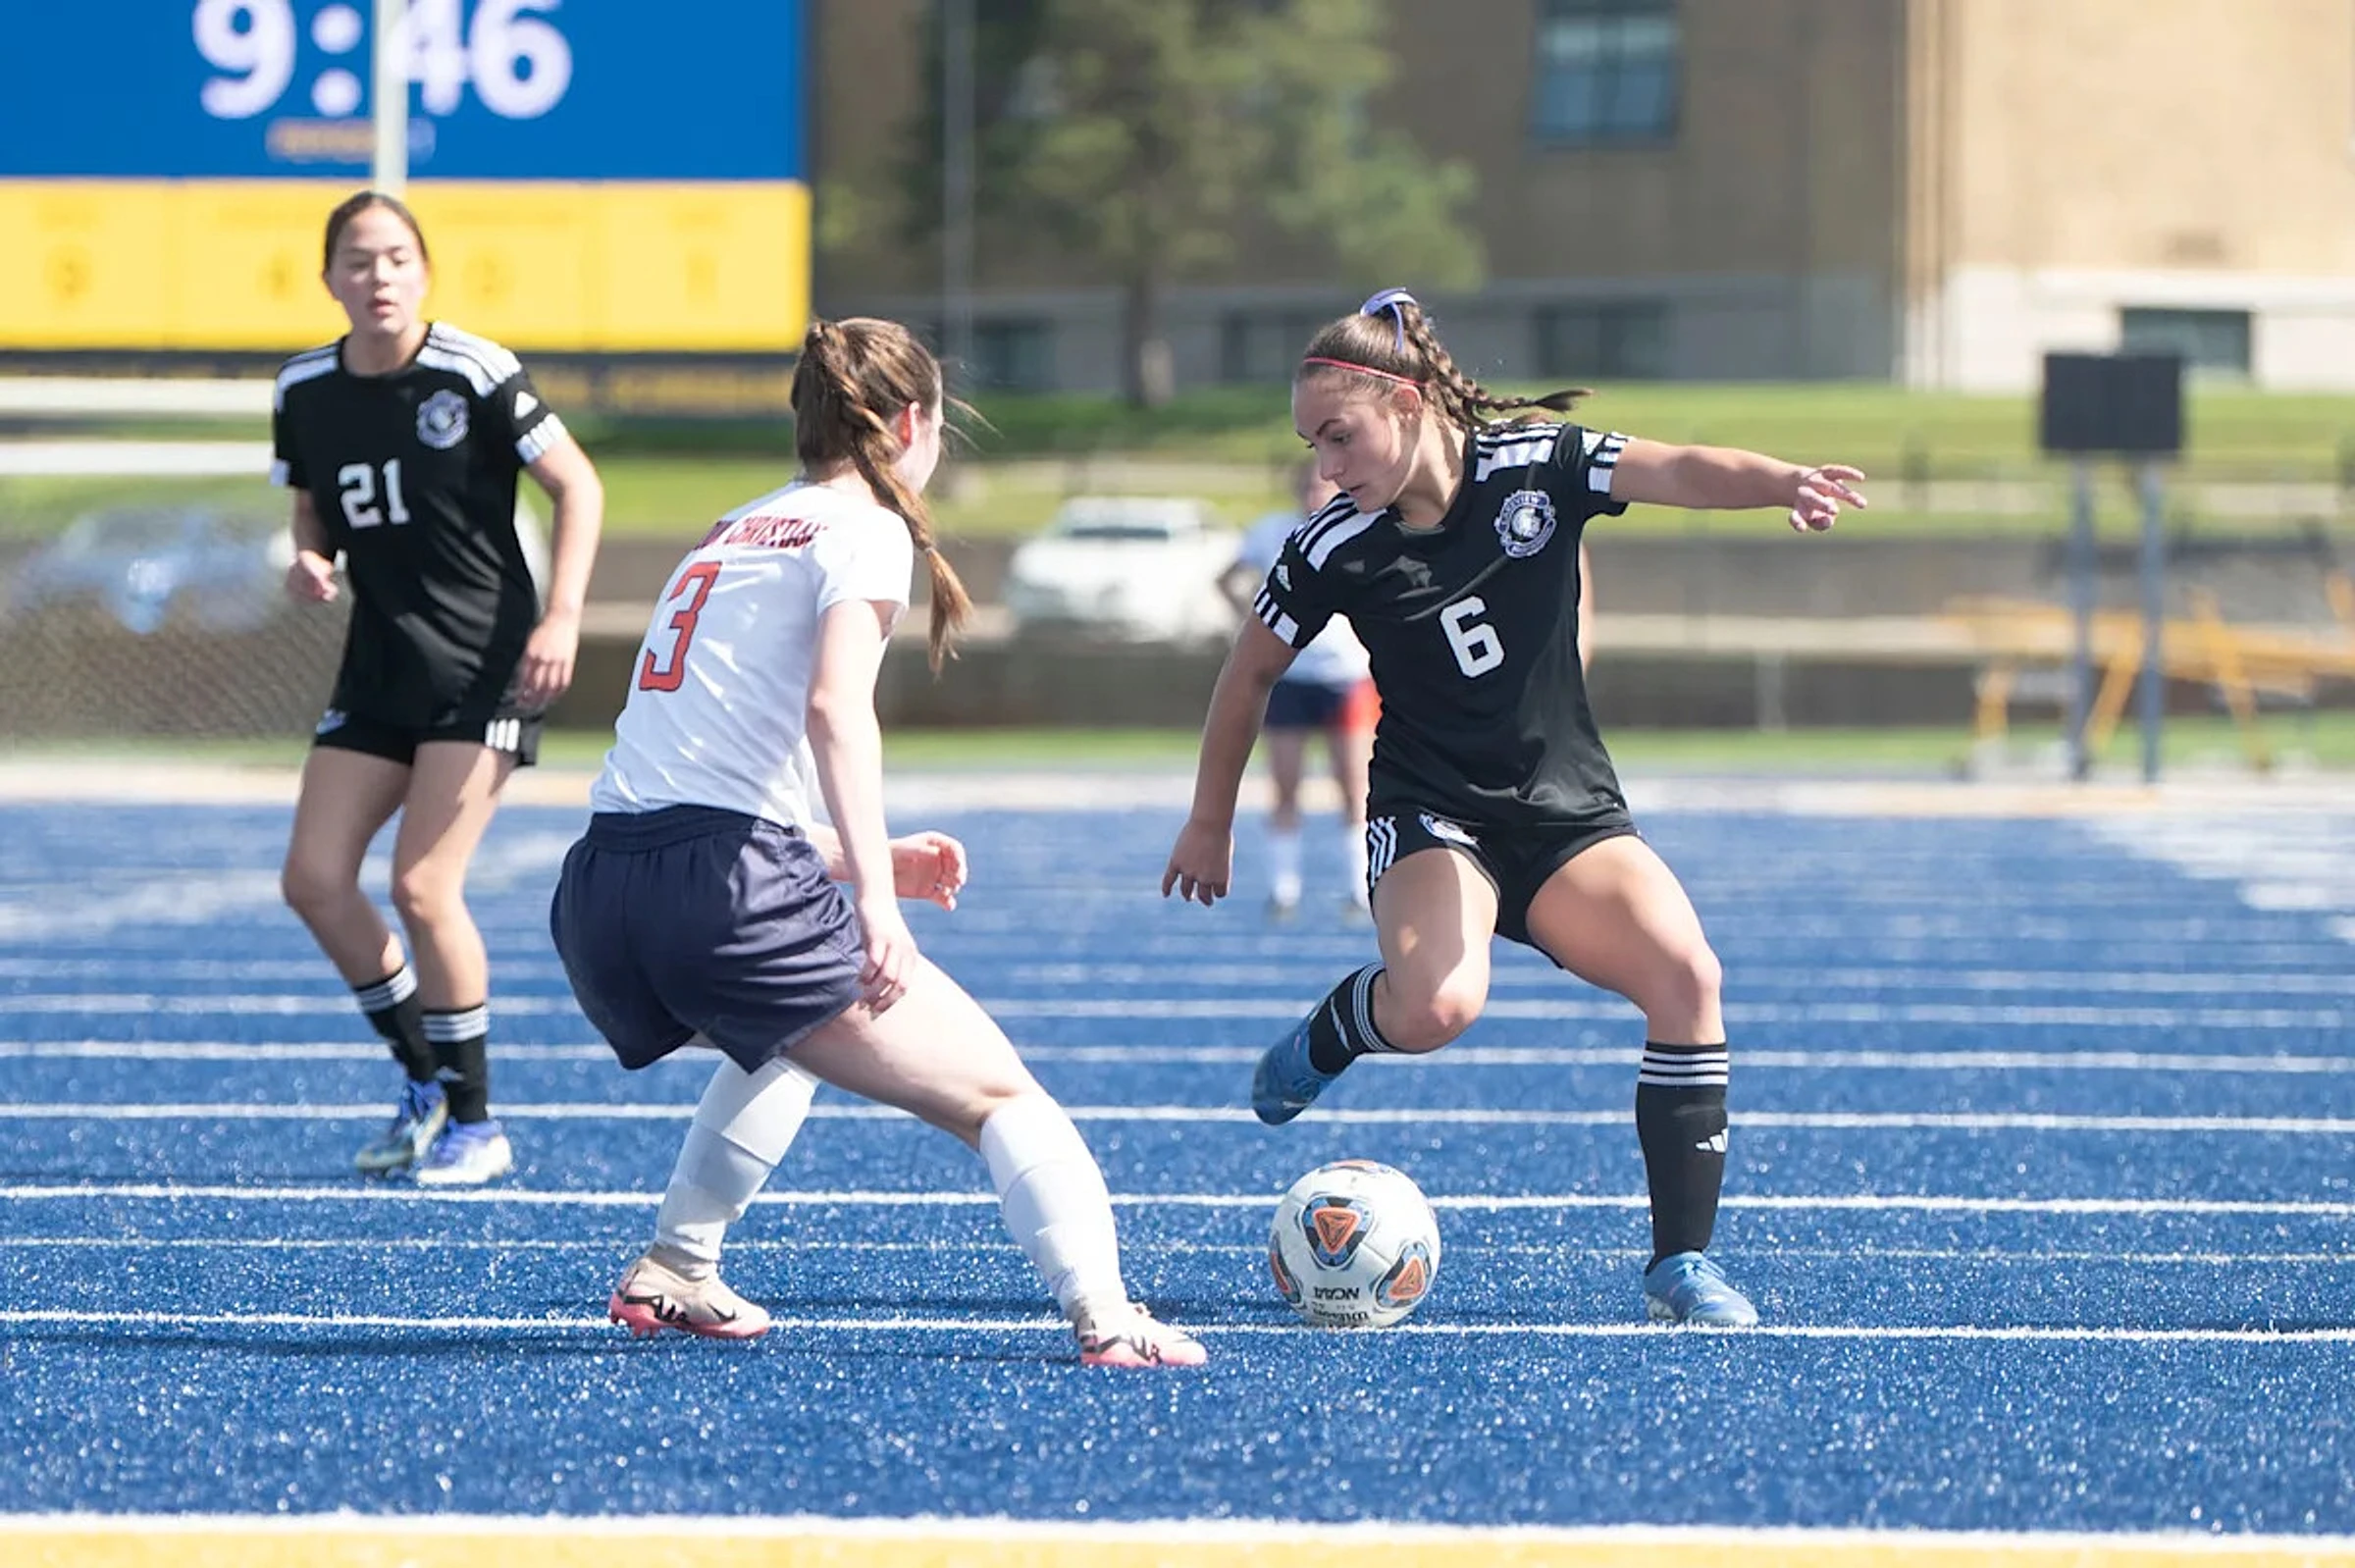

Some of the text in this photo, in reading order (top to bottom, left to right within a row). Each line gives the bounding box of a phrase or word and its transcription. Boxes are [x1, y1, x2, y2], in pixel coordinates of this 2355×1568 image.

[193, 0, 572, 119] 9:46
[338, 458, 411, 529] 21
[639, 560, 723, 693] 3
[1439, 595, 1505, 679] 6
[1315, 1286, 1360, 1300] NCAA
